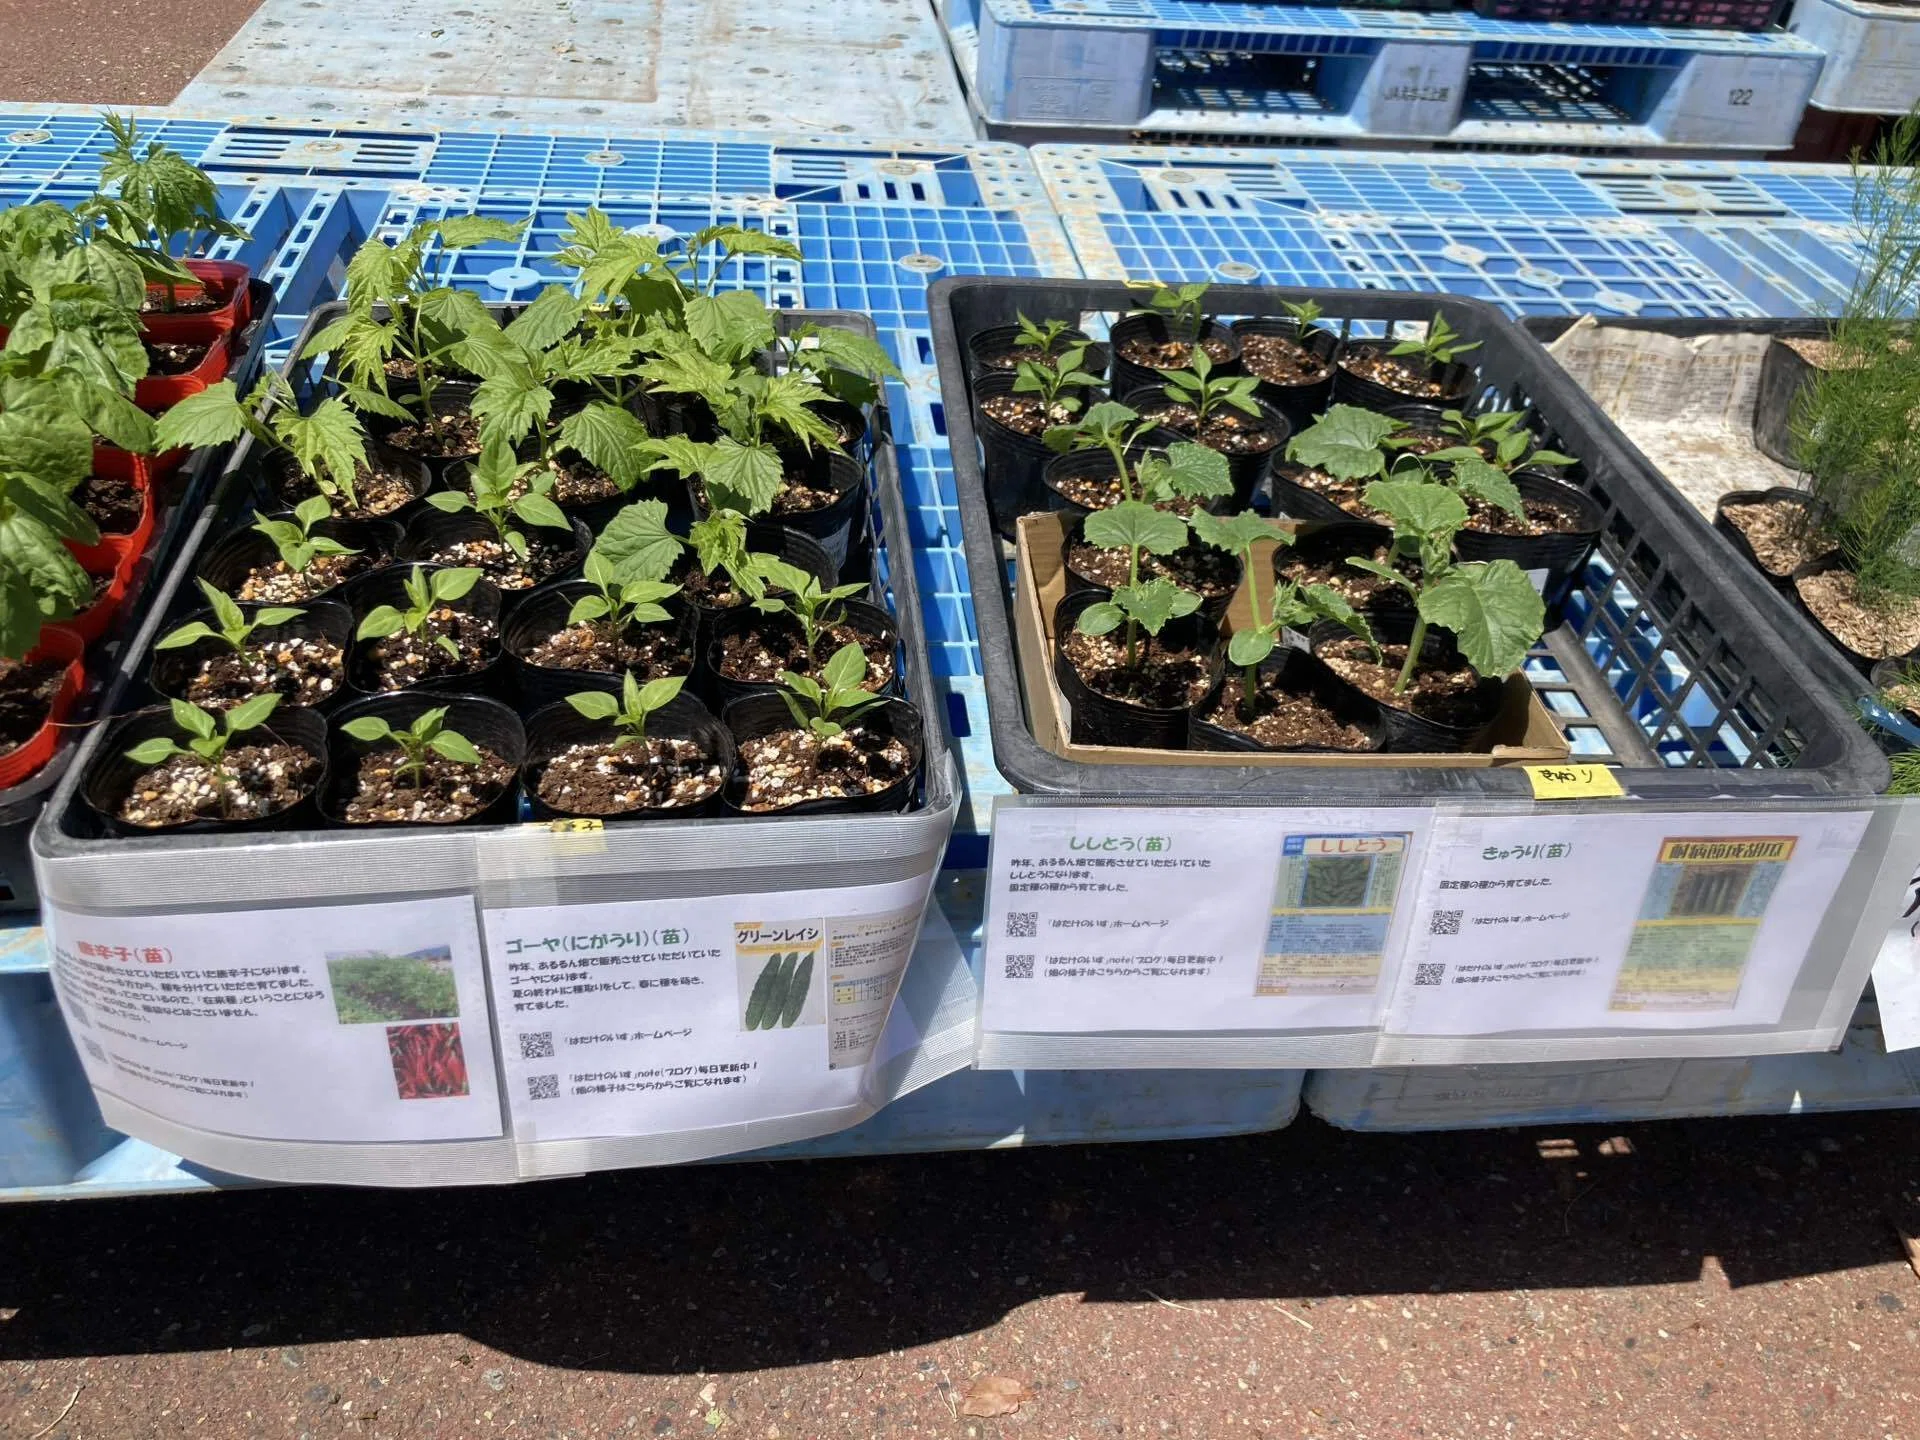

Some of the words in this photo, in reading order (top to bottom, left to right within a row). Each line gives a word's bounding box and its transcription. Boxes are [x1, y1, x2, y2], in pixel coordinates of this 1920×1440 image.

[1321, 838, 1387, 852] ししとう
[737, 927, 819, 943] グリーンレイシ
[510, 971, 594, 986] ゴーヤになります。
[514, 999, 569, 1013] 育てました。
